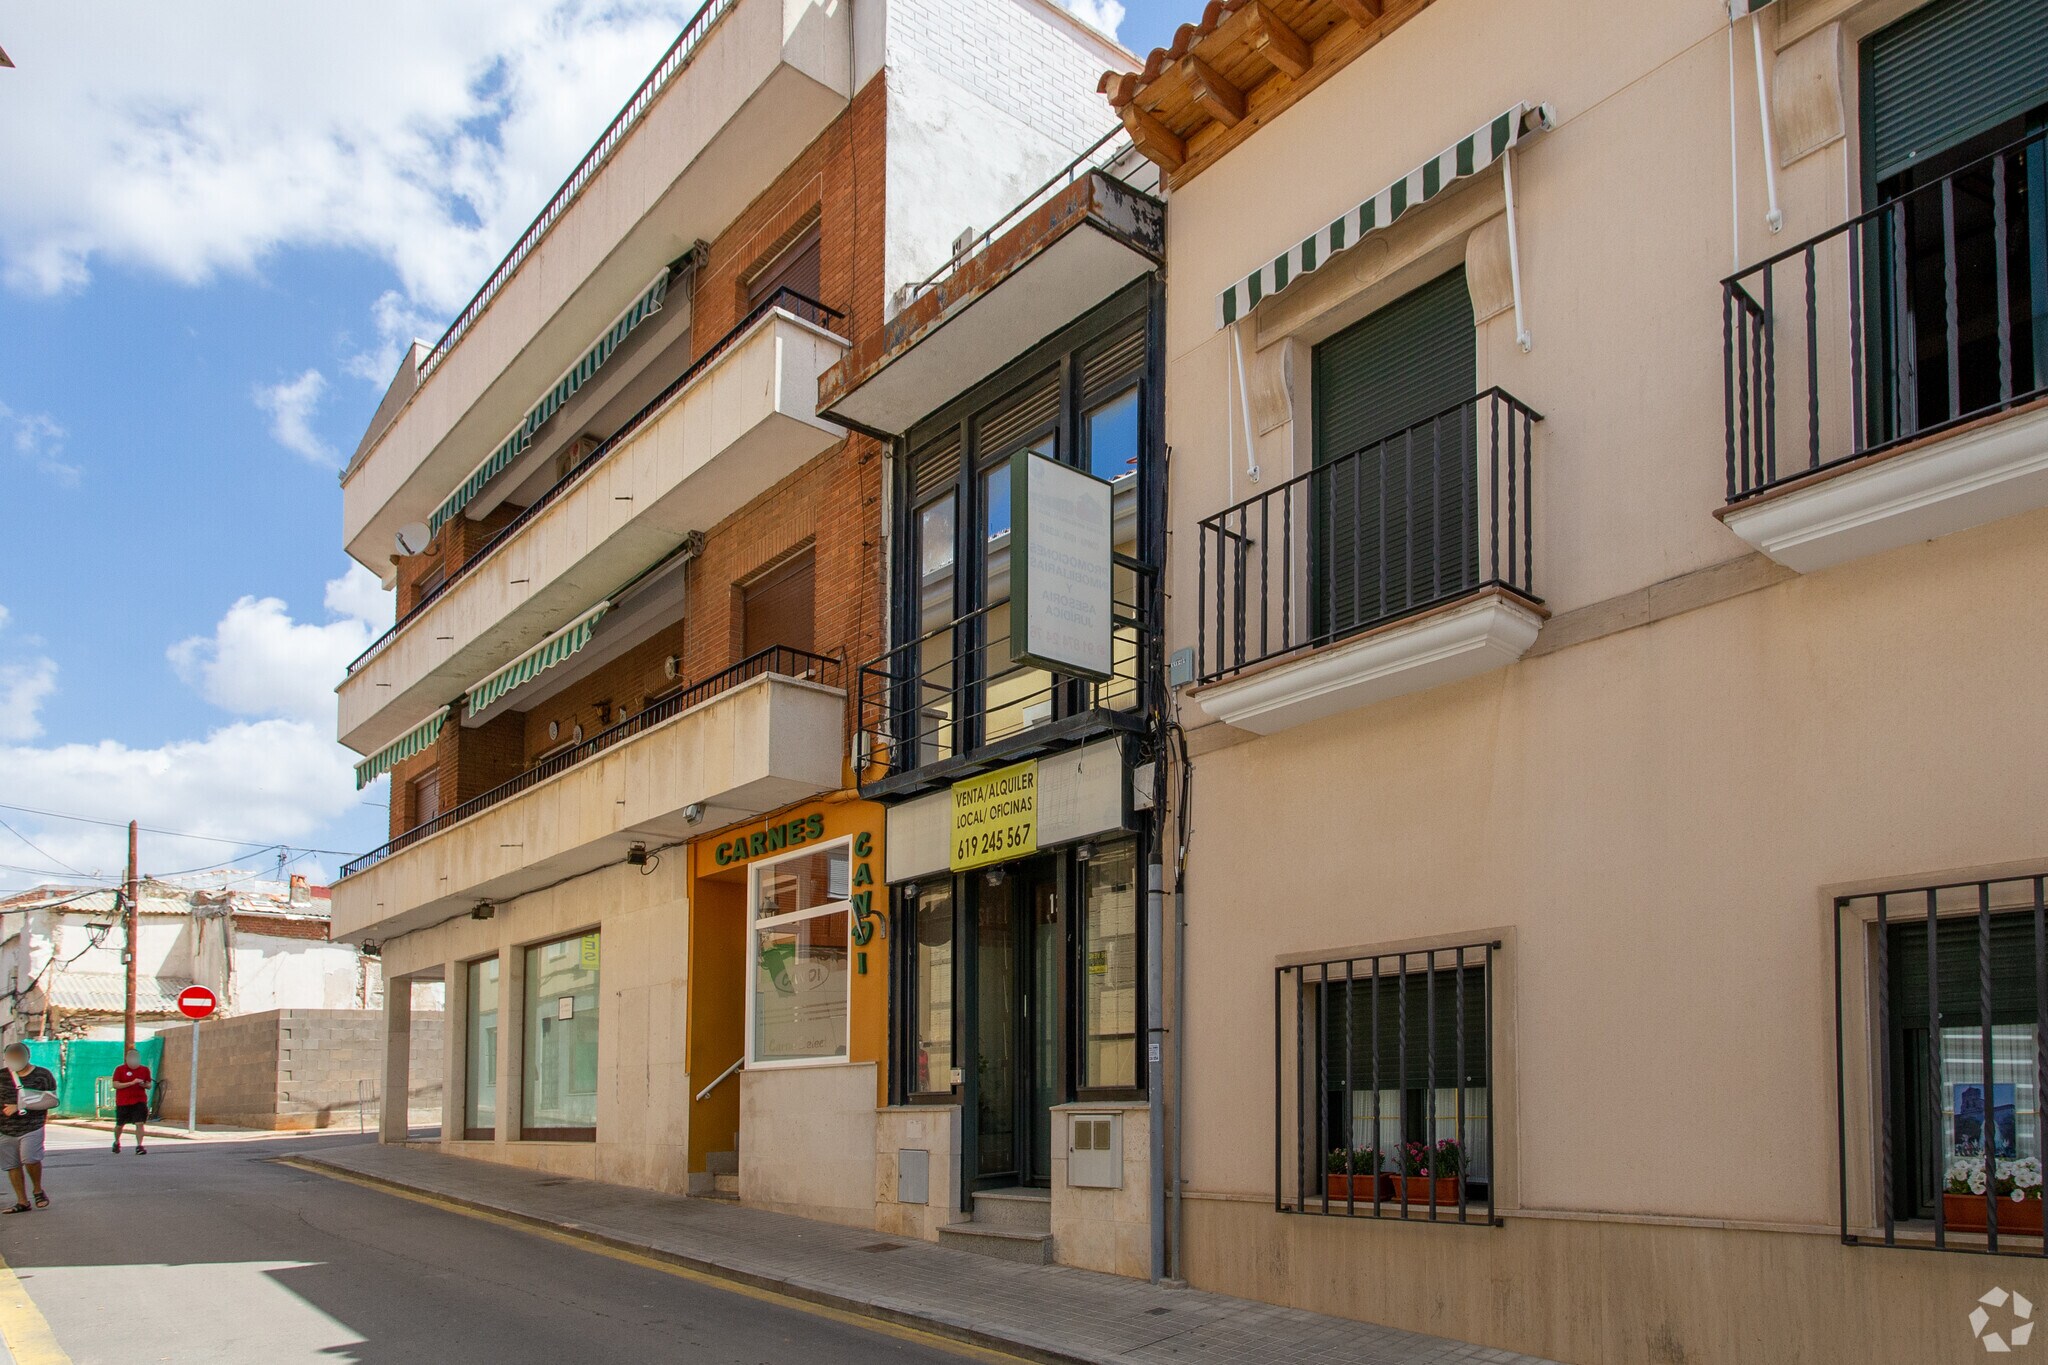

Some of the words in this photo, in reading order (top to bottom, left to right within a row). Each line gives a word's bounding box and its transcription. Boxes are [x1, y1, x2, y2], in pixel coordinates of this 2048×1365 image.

[956, 772, 1034, 808] VENTA/ALQUILER
[957, 807, 988, 829] LOCAL/
[989, 796, 1032, 820] OFICINAS
[715, 813, 824, 866] CARNES
[958, 835, 978, 860] 619
[981, 829, 1003, 855] 245
[1007, 823, 1031, 848] 567
[851, 831, 874, 975] CANDI
[1050, 893, 1058, 914] 1
[782, 968, 821, 986] CDI
